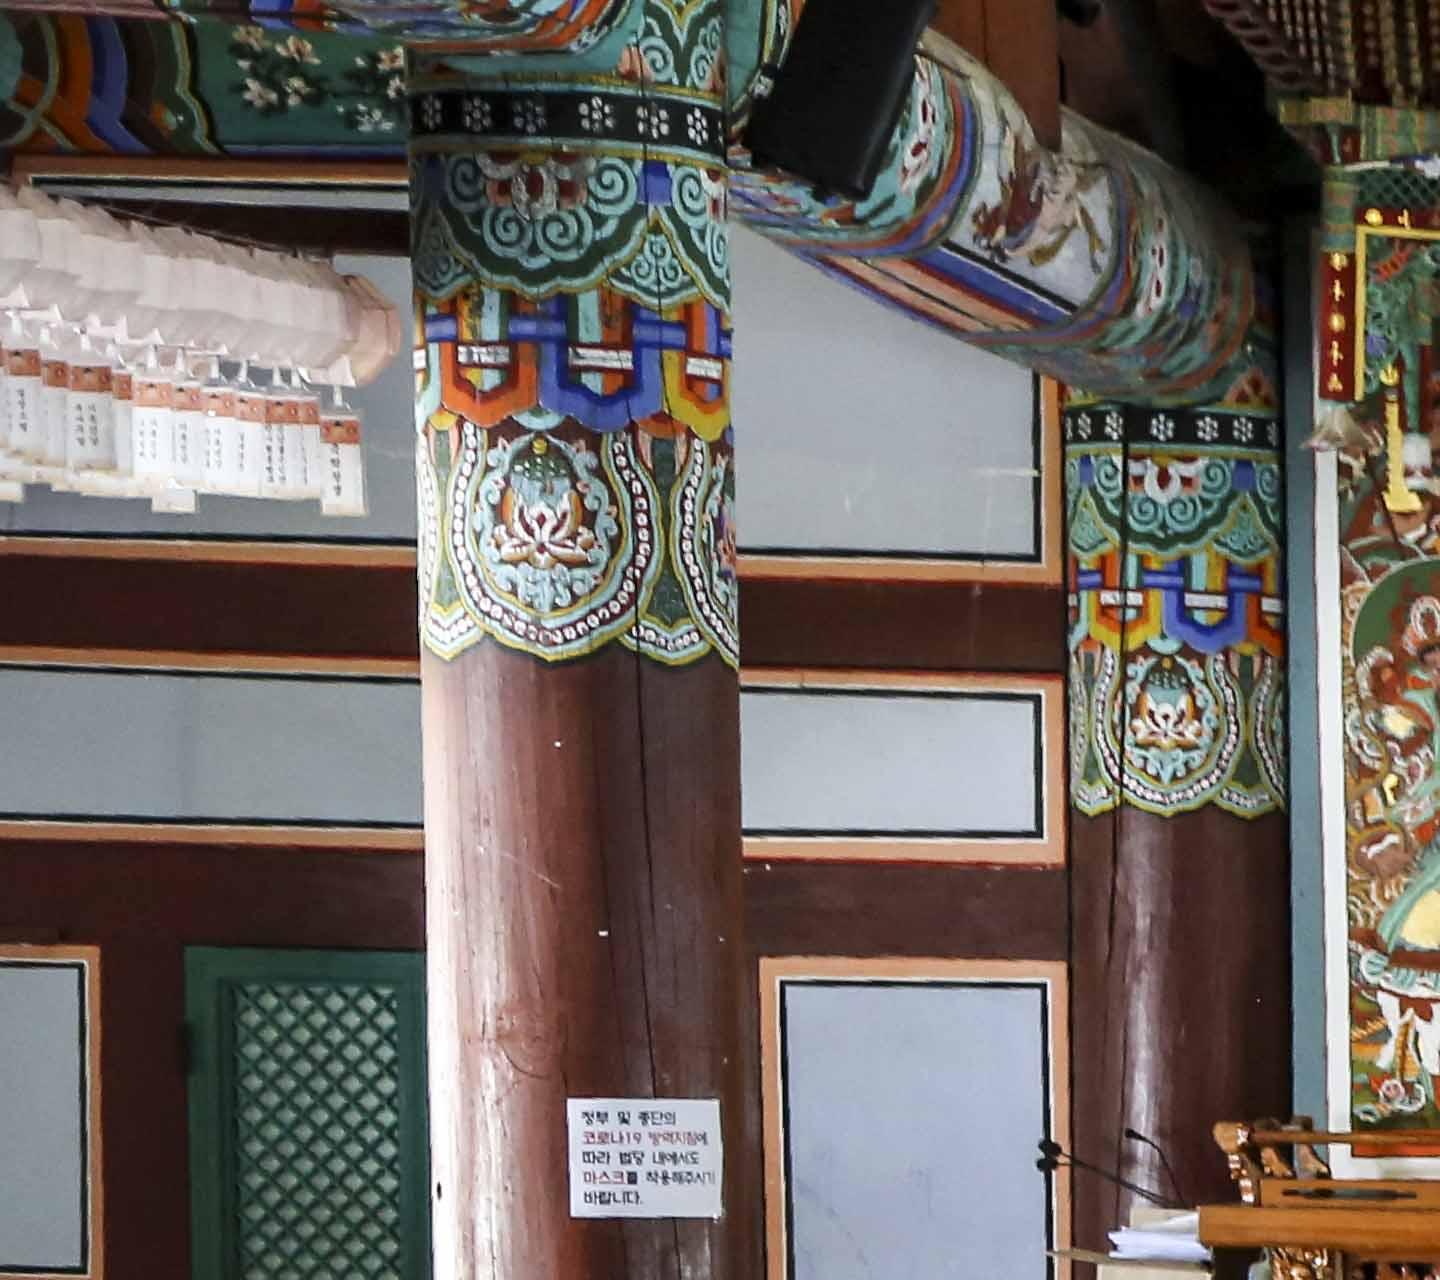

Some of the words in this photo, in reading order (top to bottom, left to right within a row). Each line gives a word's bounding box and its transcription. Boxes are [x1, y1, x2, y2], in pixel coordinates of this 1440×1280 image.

[581, 1110, 608, 1126] 정부
[617, 1110, 631, 1125] 및
[582, 1130, 643, 1146] 코로나19
[582, 1150, 611, 1166] 따라
[619, 1150, 645, 1166] 법당
